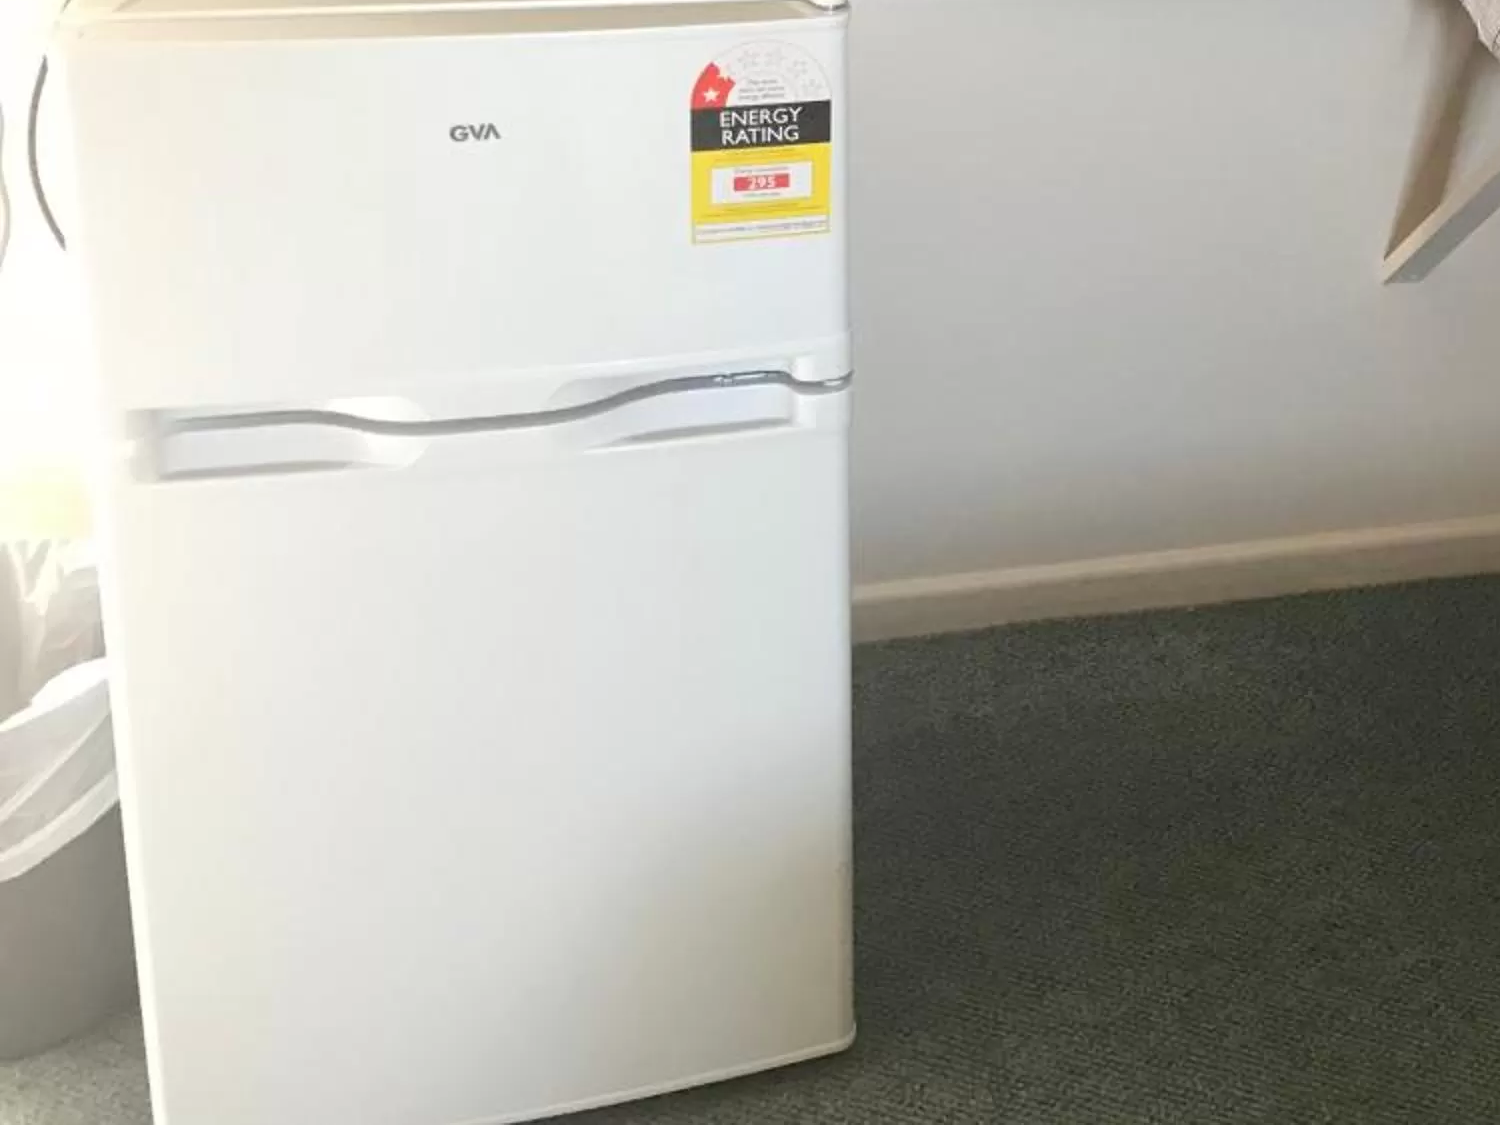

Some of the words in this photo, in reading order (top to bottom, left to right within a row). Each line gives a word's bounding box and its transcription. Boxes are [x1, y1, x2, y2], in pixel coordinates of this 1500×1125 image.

[719, 107, 803, 128] ENERGY
[449, 123, 502, 142] GVA
[721, 125, 800, 146] RATING
